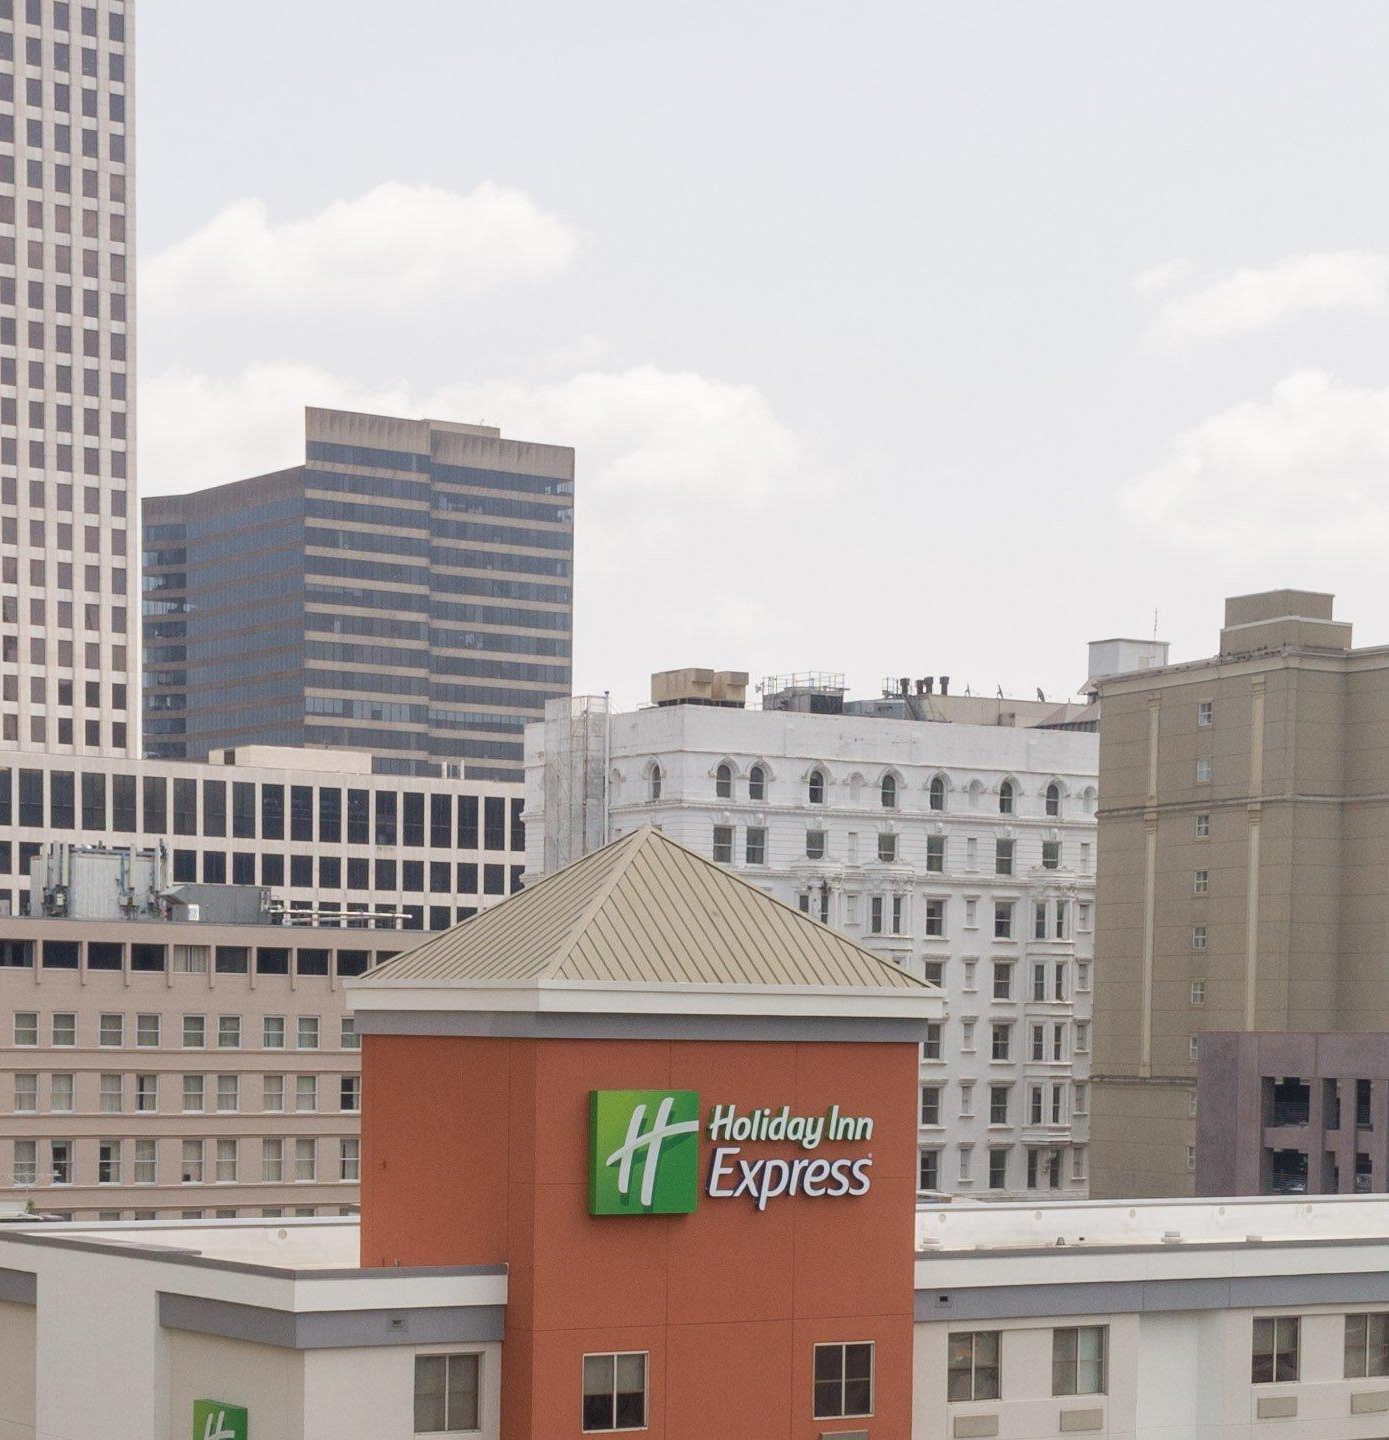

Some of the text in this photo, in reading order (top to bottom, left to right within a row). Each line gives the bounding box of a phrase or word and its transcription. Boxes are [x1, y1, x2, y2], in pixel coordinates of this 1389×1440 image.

[709, 1105, 874, 1149] Holiday Inn
[707, 1147, 873, 1210] Express
